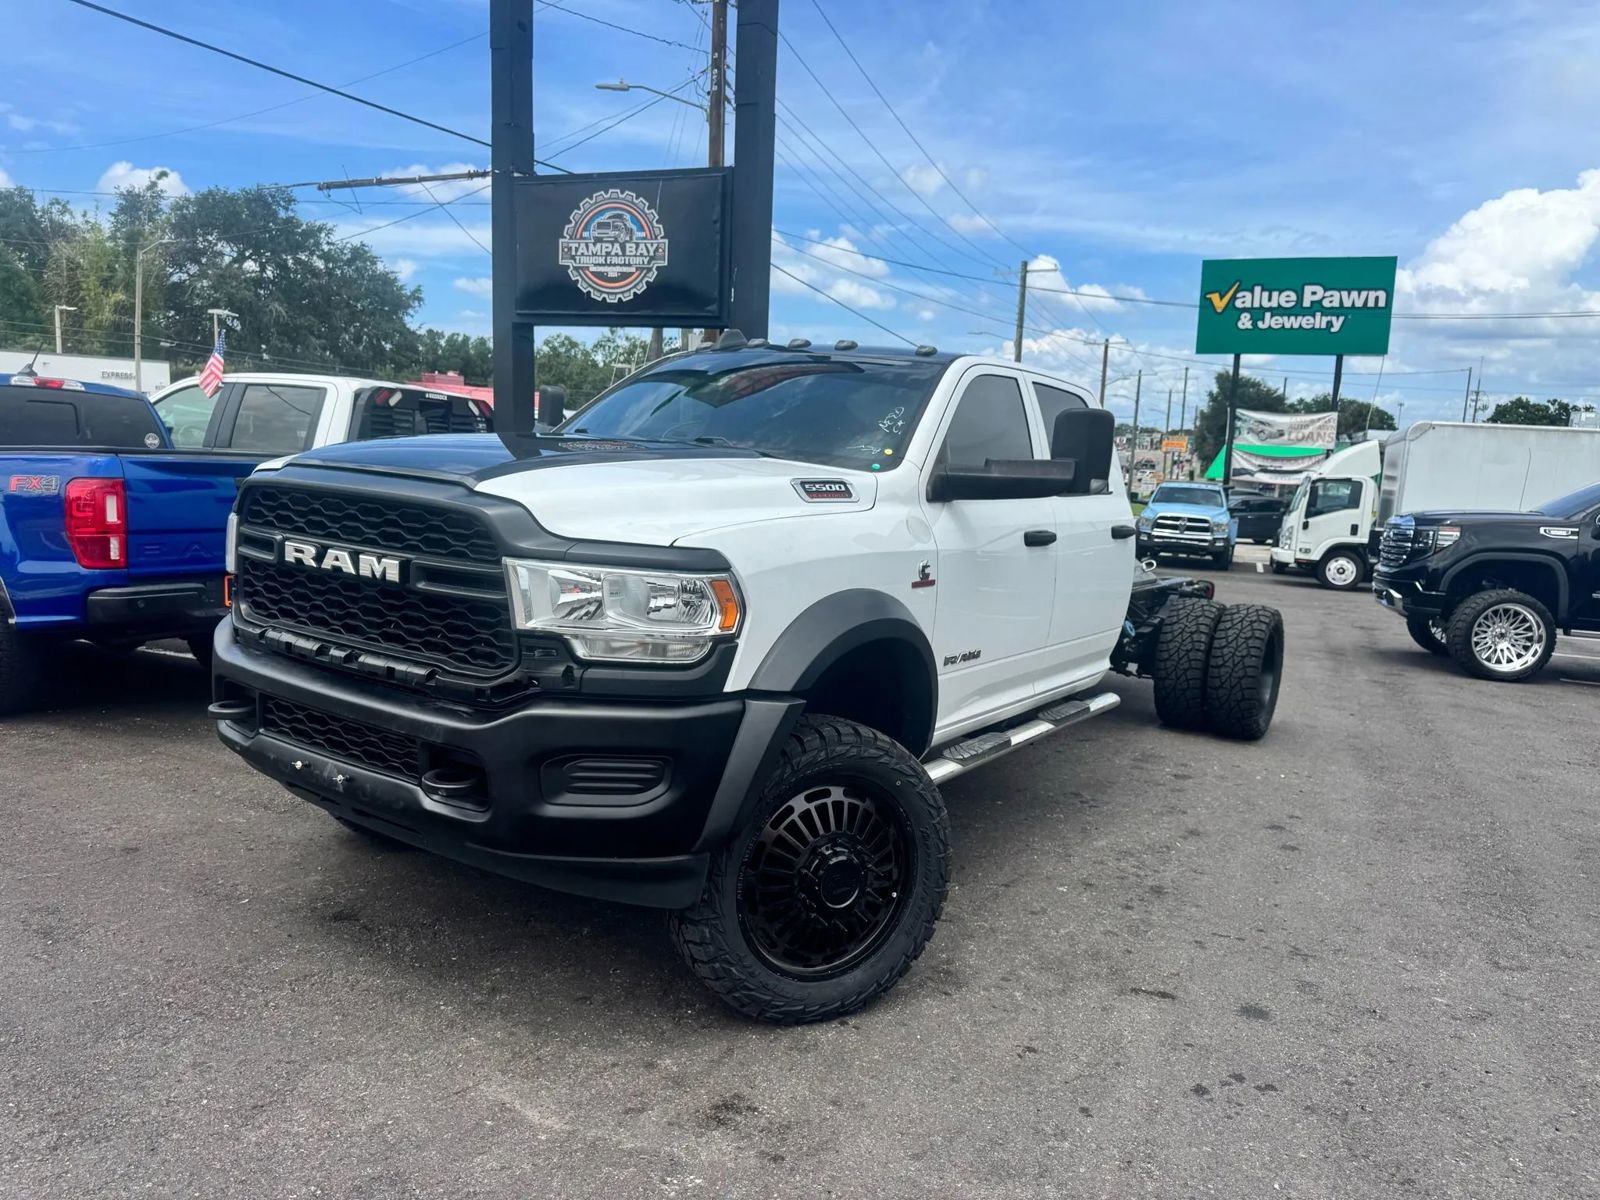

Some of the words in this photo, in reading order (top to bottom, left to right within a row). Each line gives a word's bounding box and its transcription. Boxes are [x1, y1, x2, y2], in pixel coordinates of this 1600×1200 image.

[570, 243, 622, 256] TAMPA
[626, 243, 658, 256] BAY
[575, 256, 606, 264] TRUCK
[607, 256, 650, 265] FACTORY
[1302, 285, 1387, 308] Pawn
[1237, 312, 1253, 329] &
[1257, 312, 1344, 332] Jewelry
[1288, 431, 1334, 443] LOANS
[9, 475, 60, 493] FX4
[804, 483, 846, 492] 5500
[284, 541, 400, 583] RAM
